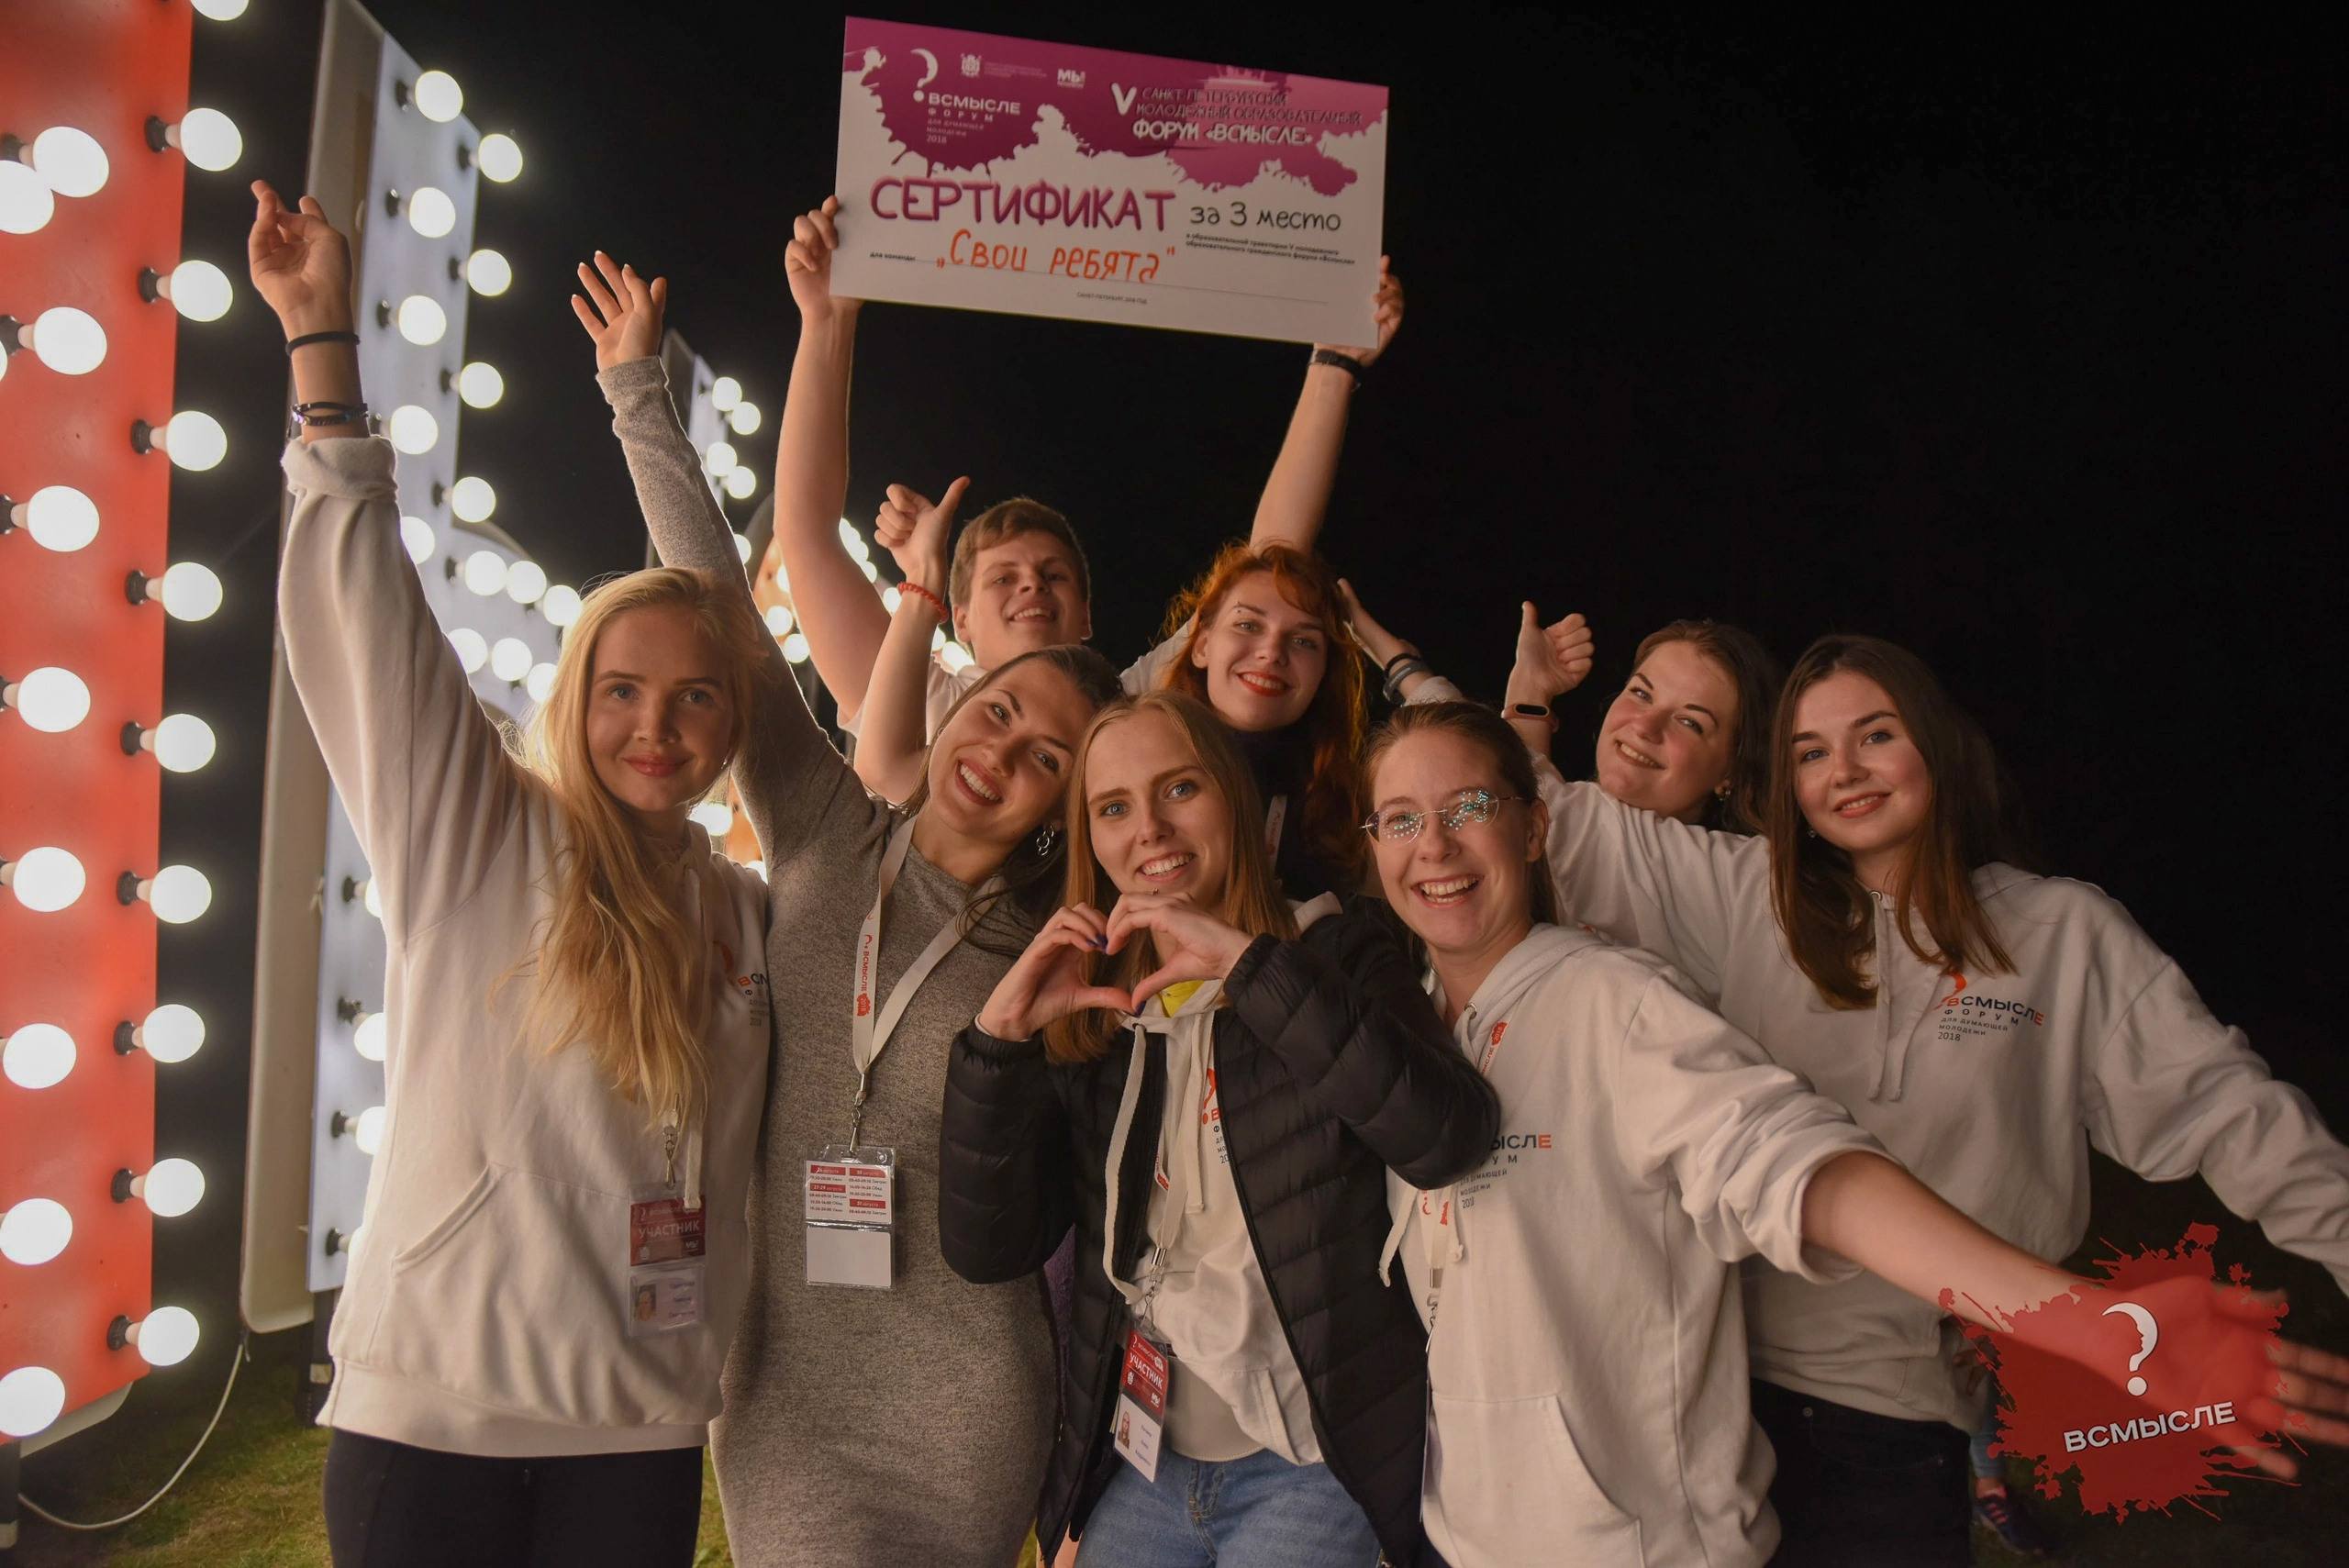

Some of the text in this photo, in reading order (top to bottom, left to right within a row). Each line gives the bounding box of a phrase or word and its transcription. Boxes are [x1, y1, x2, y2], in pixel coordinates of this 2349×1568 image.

[929, 92, 1020, 116] ВСМЫСЛЕ
[1111, 83, 1137, 116] V
[927, 134, 947, 144] 2018
[1132, 118, 1199, 140] ФОРУМ
[871, 177, 1176, 231] СЕРТИФИКАТ
[1190, 201, 1341, 231] за 3 место
[862, 951, 870, 991] ВСМЫСЛЕ
[1944, 1009, 2019, 1026] ФОРУМ
[1947, 996, 2044, 1026] ВСМЫСЛЕ
[1938, 1031, 1961, 1041] 2018
[639, 1220, 699, 1239] УЧАСТНИК
[1130, 1352, 1163, 1389] УЧАСТНИК
